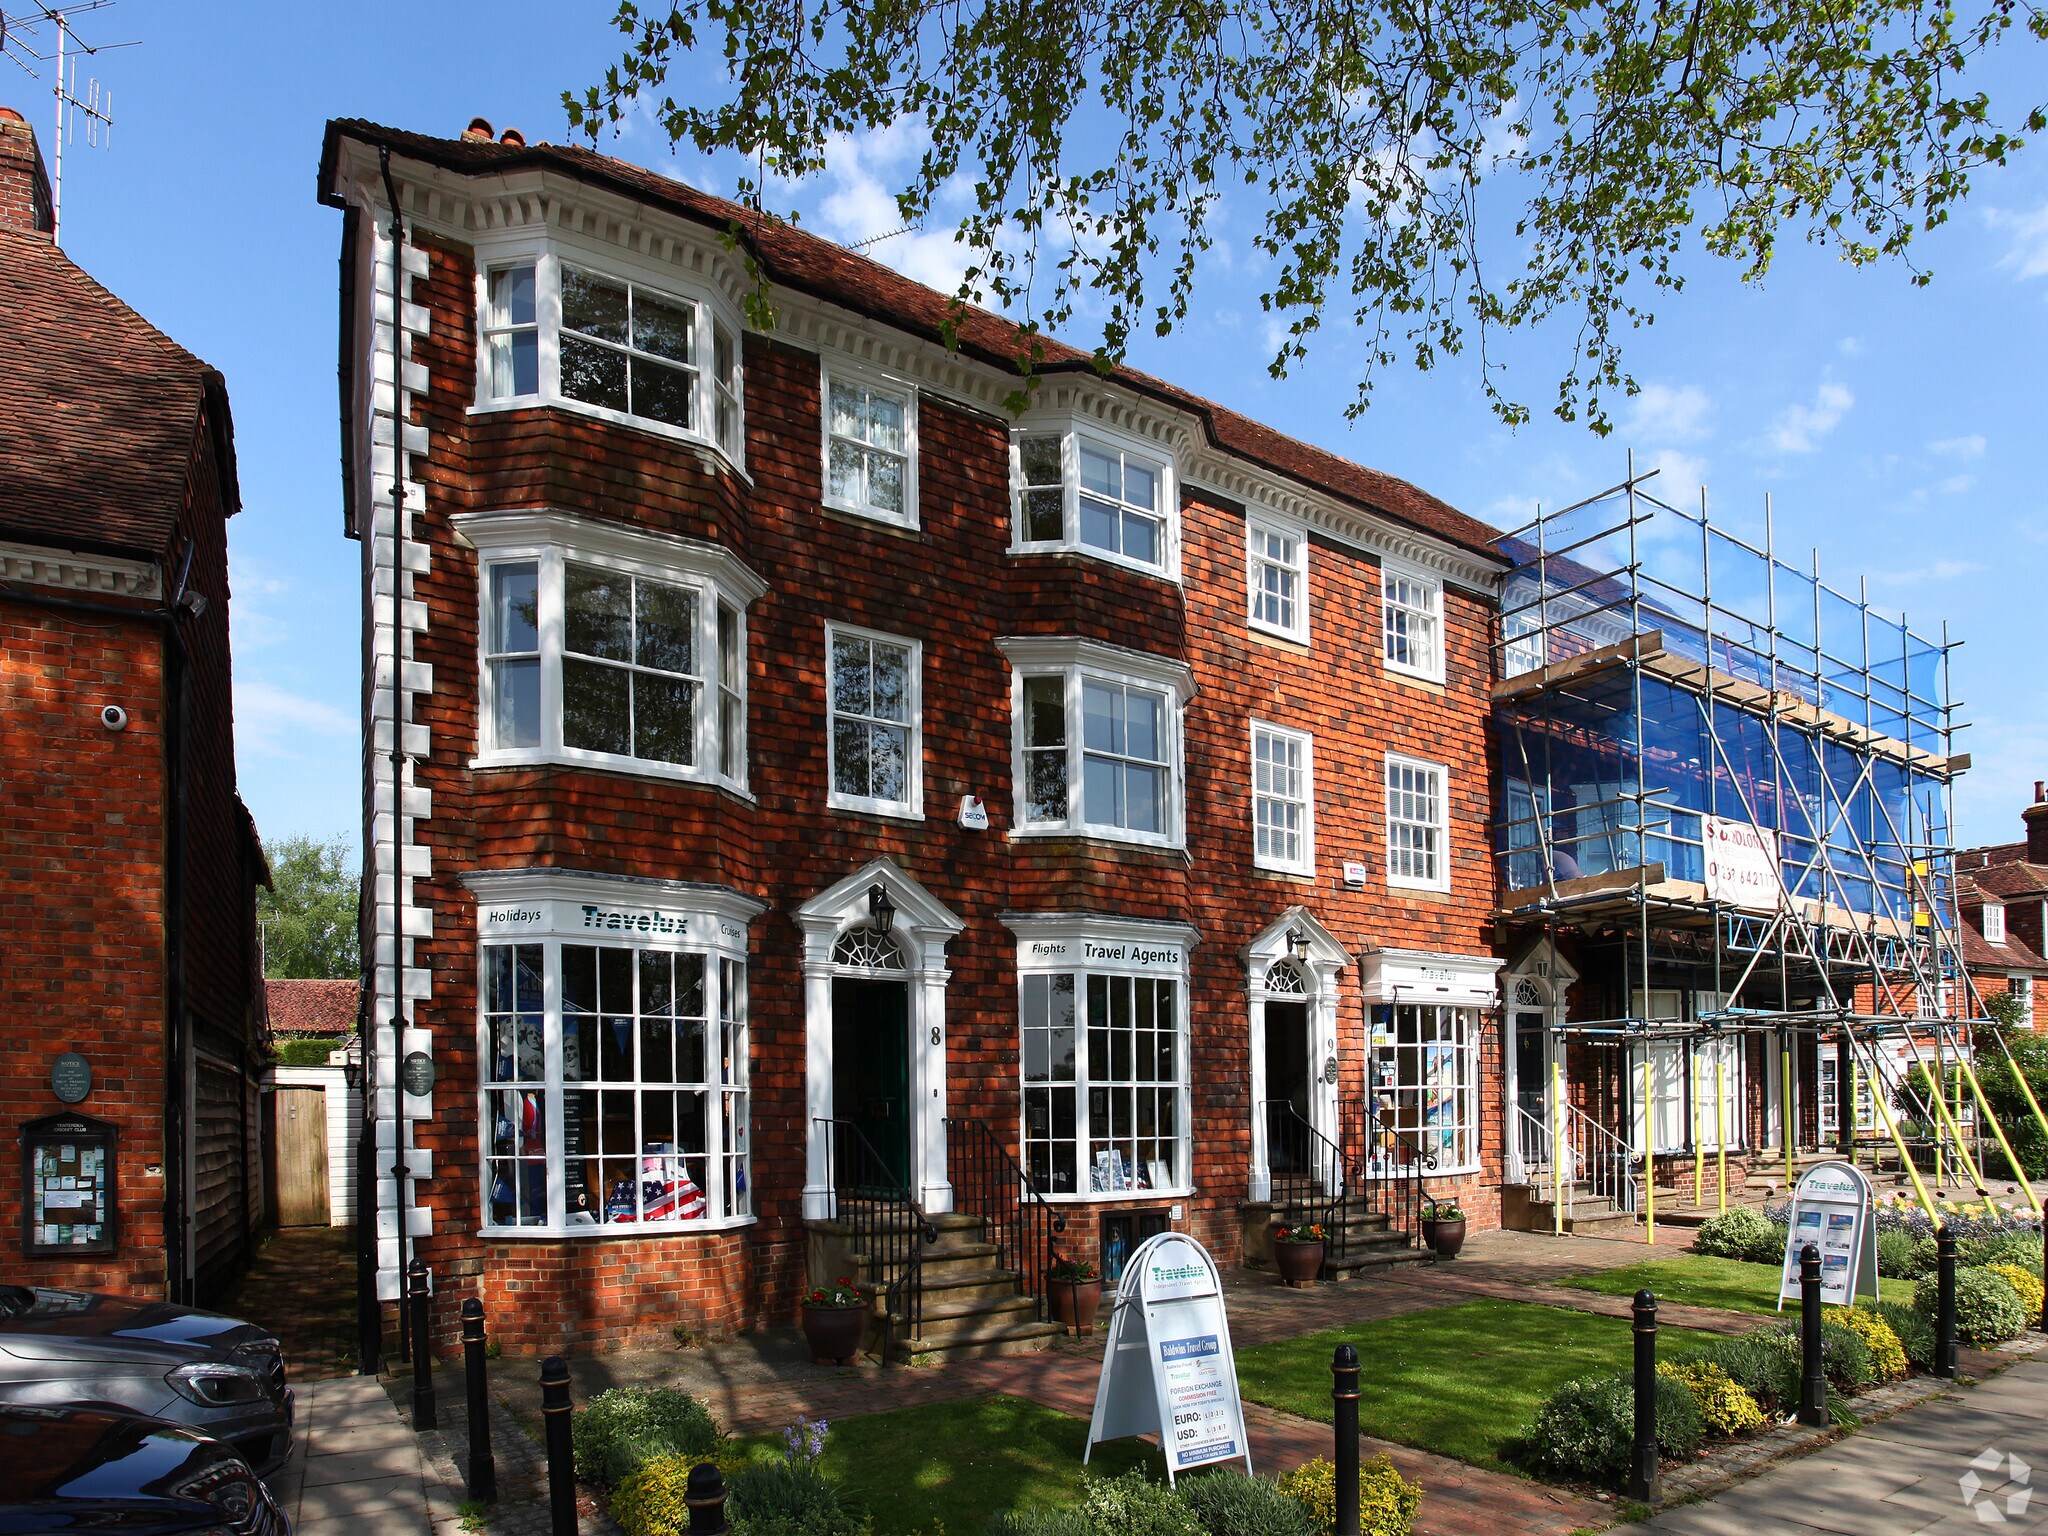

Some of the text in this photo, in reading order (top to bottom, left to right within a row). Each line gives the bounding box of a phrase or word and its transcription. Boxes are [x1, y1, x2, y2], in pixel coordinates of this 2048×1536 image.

[965, 812, 985, 821] SECOM
[489, 909, 541, 923] Holidays
[581, 905, 689, 934] Travelux
[720, 924, 741, 938] Cruises
[1032, 943, 1066, 956] Flights
[1084, 943, 1178, 964] Travel Agents
[1420, 966, 1457, 981] Travelux
[931, 1026, 941, 1046] 8
[1327, 1038, 1334, 1053] 9
[1809, 1180, 1857, 1192] Travelux
[1152, 1264, 1205, 1281] Travelux
[1163, 1339, 1217, 1357] Baldwins Travel Group
[1170, 1380, 1222, 1395] FOREIGN EXCHANGE
[1178, 1392, 1206, 1402] COMMISSION
[1174, 1412, 1202, 1425] EURO:
[1177, 1428, 1198, 1441] USD:
[1189, 1448, 1208, 1456] MINIMUM
[1208, 1443, 1230, 1453] PURCHASE
